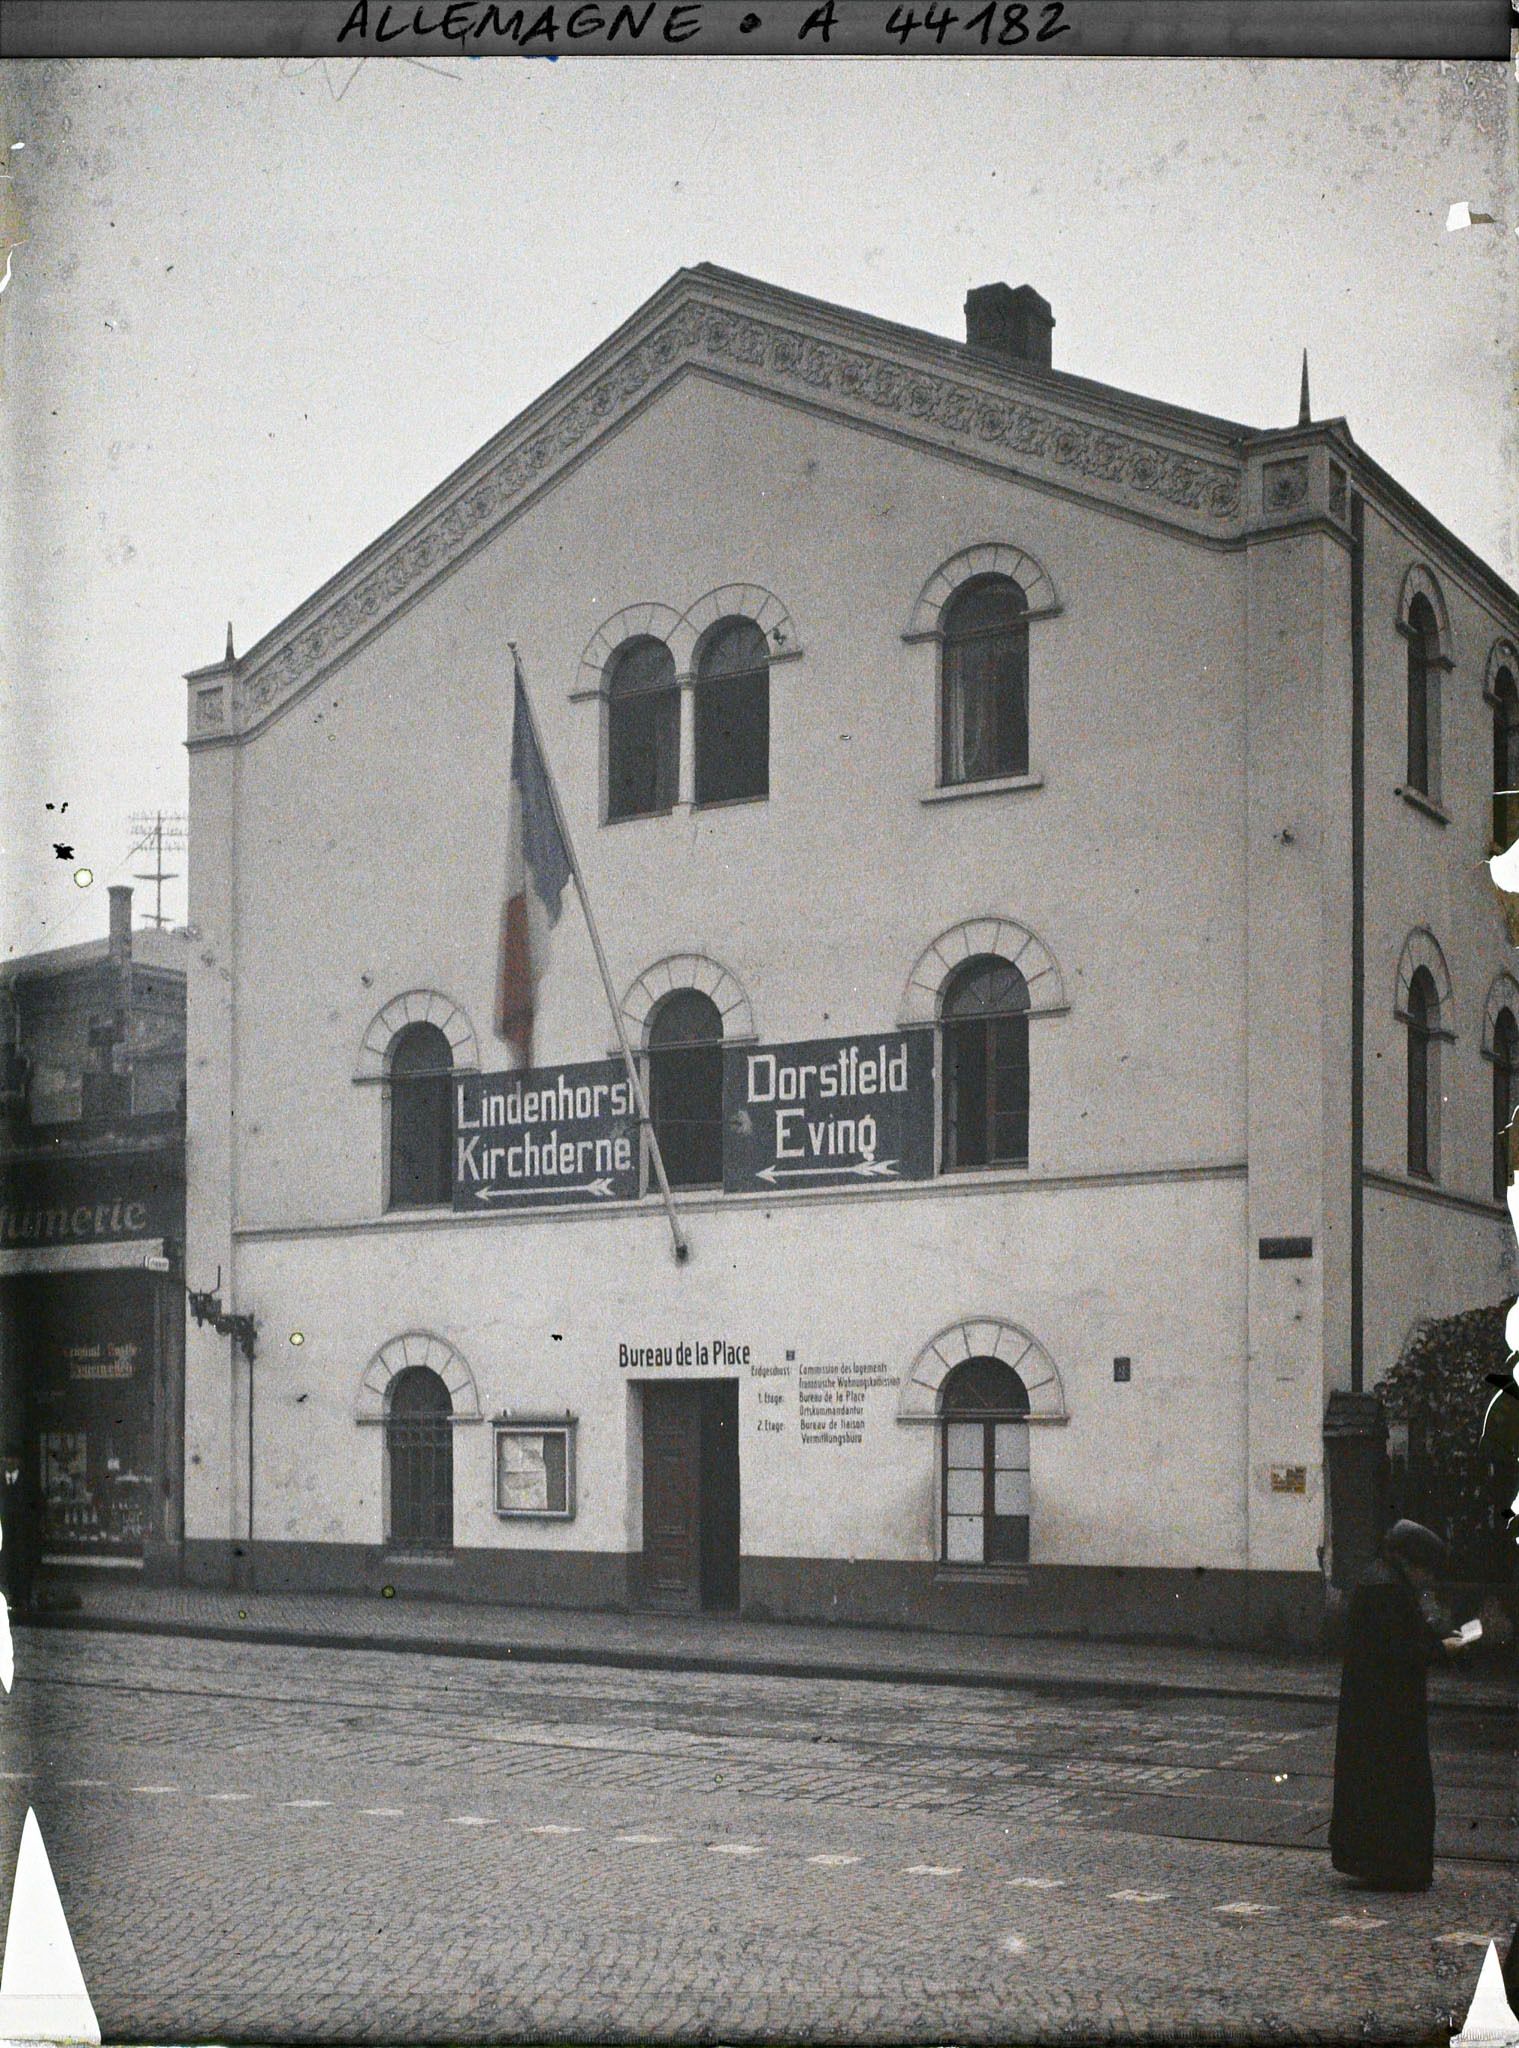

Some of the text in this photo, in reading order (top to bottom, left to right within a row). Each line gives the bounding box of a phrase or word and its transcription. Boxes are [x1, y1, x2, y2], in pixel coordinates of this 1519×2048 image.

[746, 1044, 909, 1103] Dorstfeld
[456, 1078, 636, 1130] Lindenhorst
[774, 1107, 878, 1161] Eving
[618, 1340, 751, 1368] Bureau de la Place
[799, 1391, 822, 1403] Bureau
[824, 1391, 833, 1402] de
[846, 1390, 866, 1402] Place
[800, 1419, 827, 1431] Bureau
[829, 1419, 839, 1430] de
